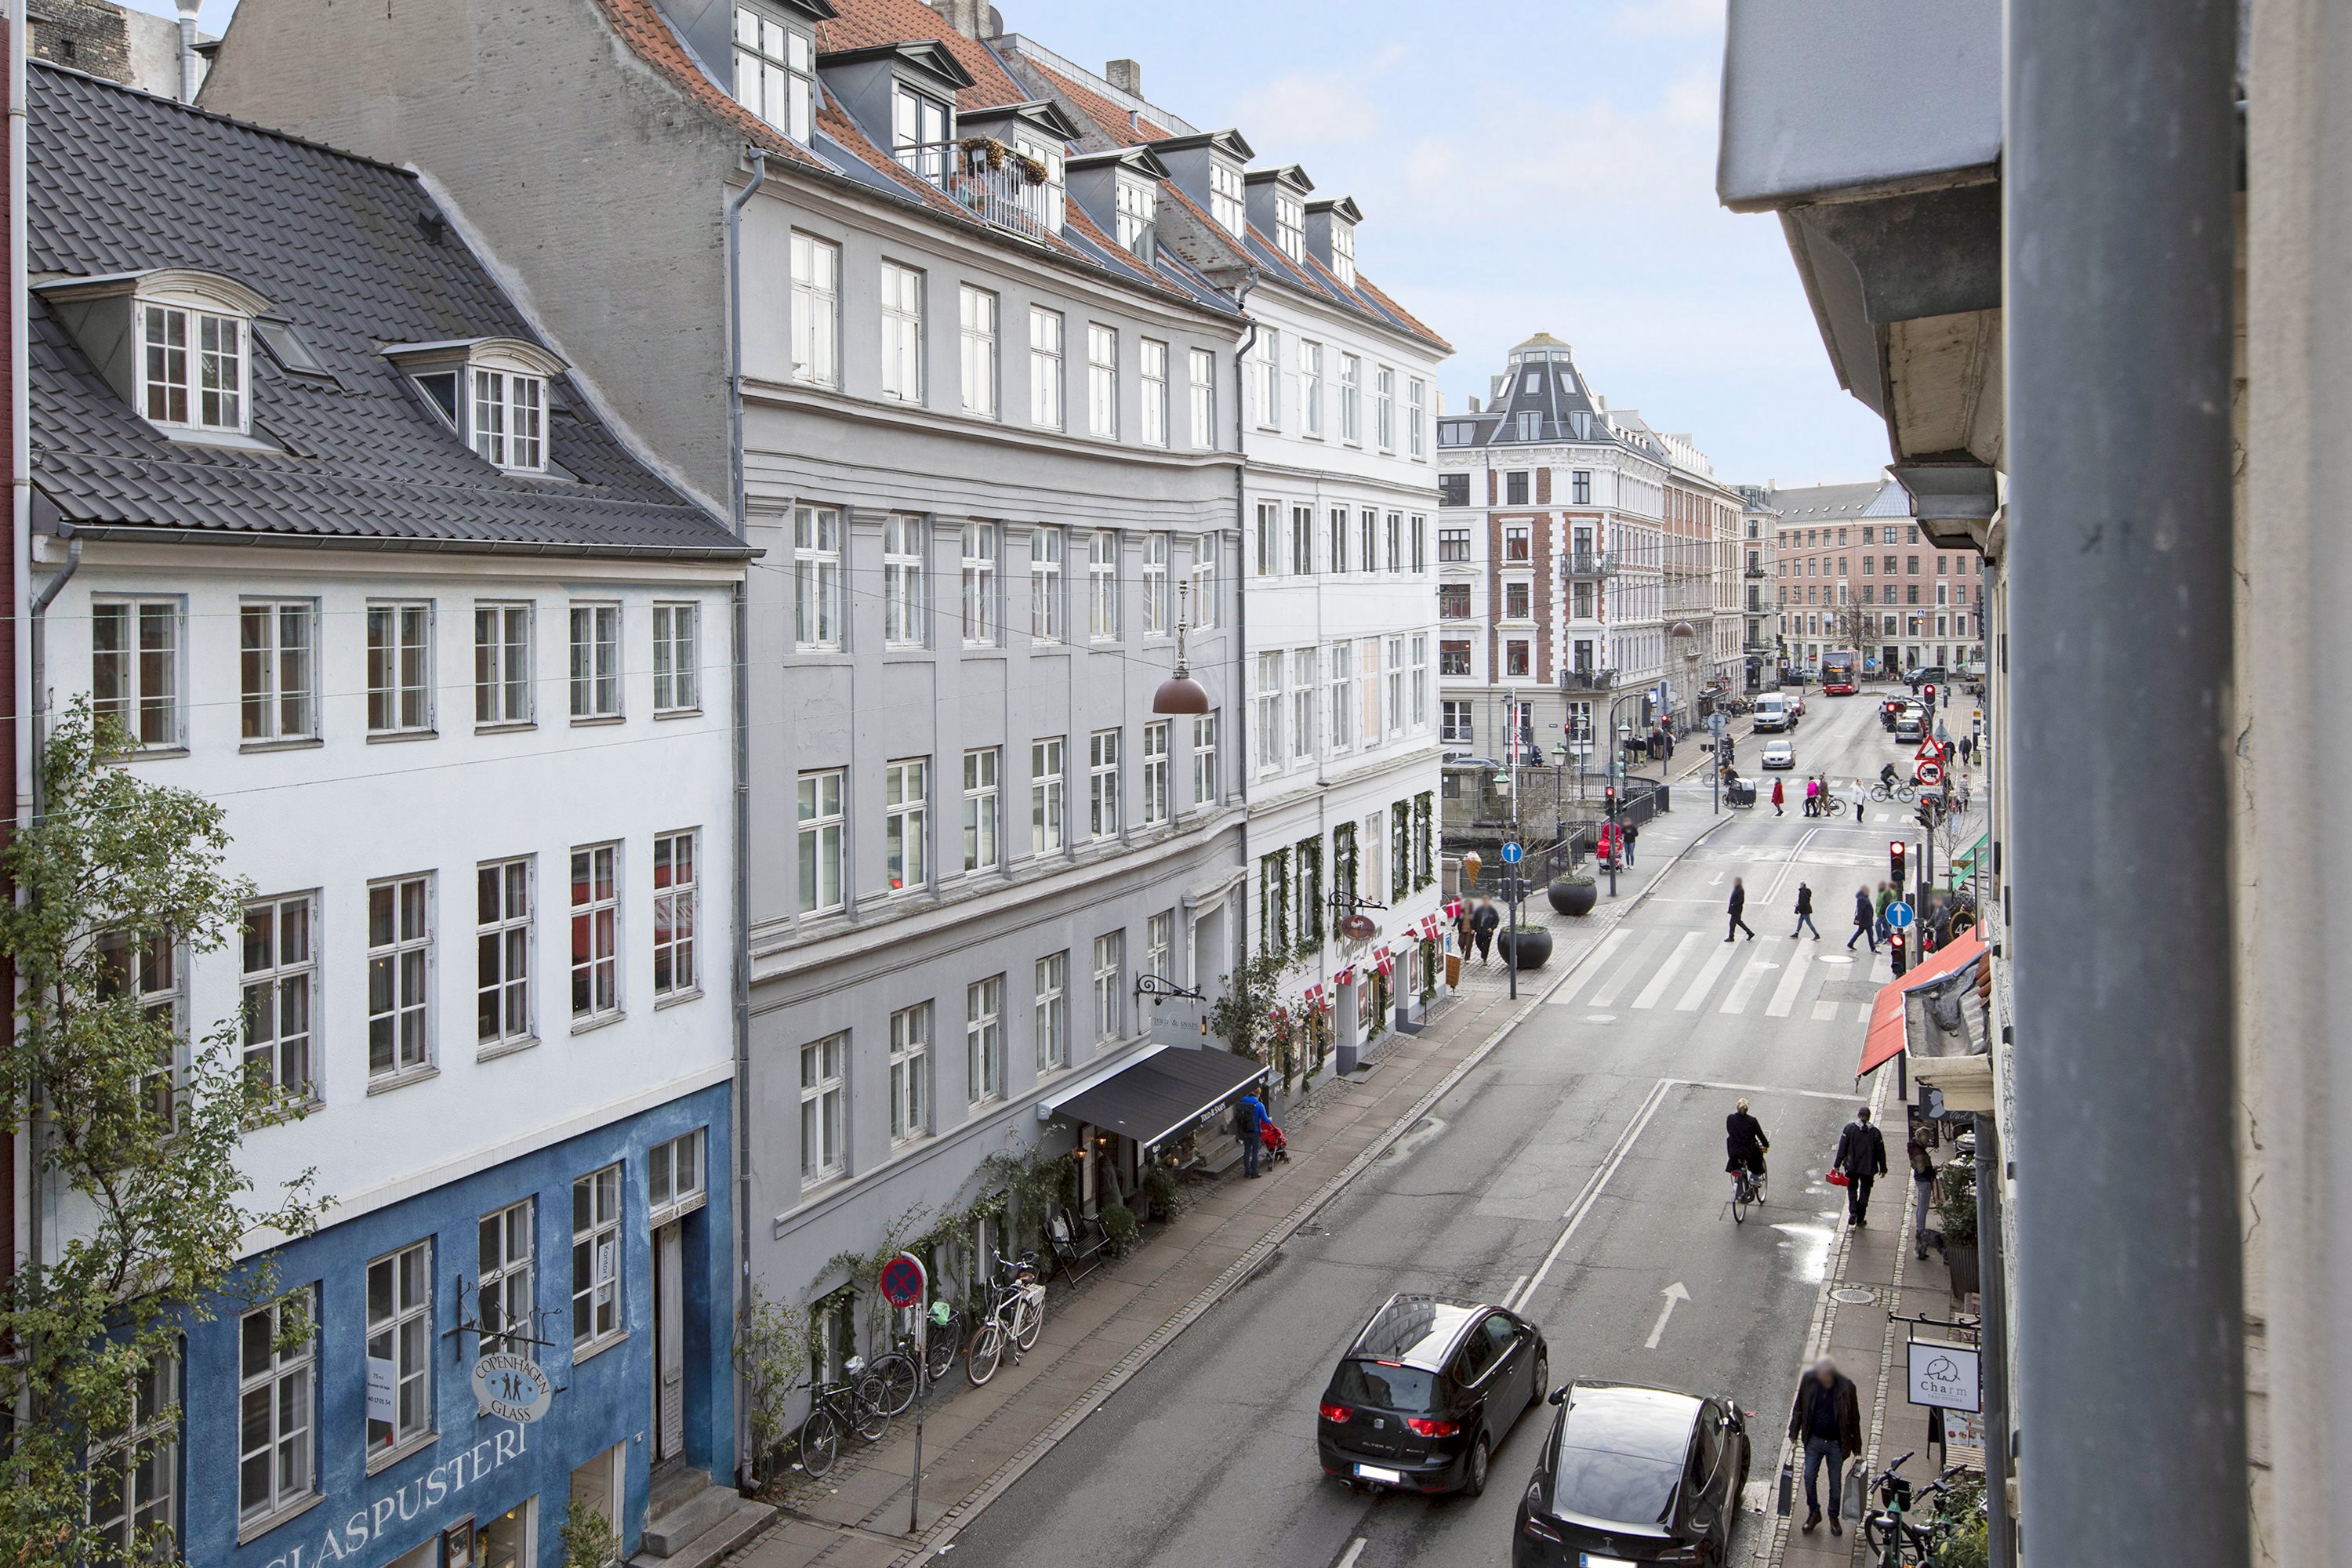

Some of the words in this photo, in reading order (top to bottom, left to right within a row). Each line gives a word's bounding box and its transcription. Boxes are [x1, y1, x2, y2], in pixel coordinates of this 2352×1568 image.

[475, 1356, 550, 1395] COPENHAGEN
[1921, 1381, 1967, 1396] Charm
[491, 1399, 532, 1421] GLASS
